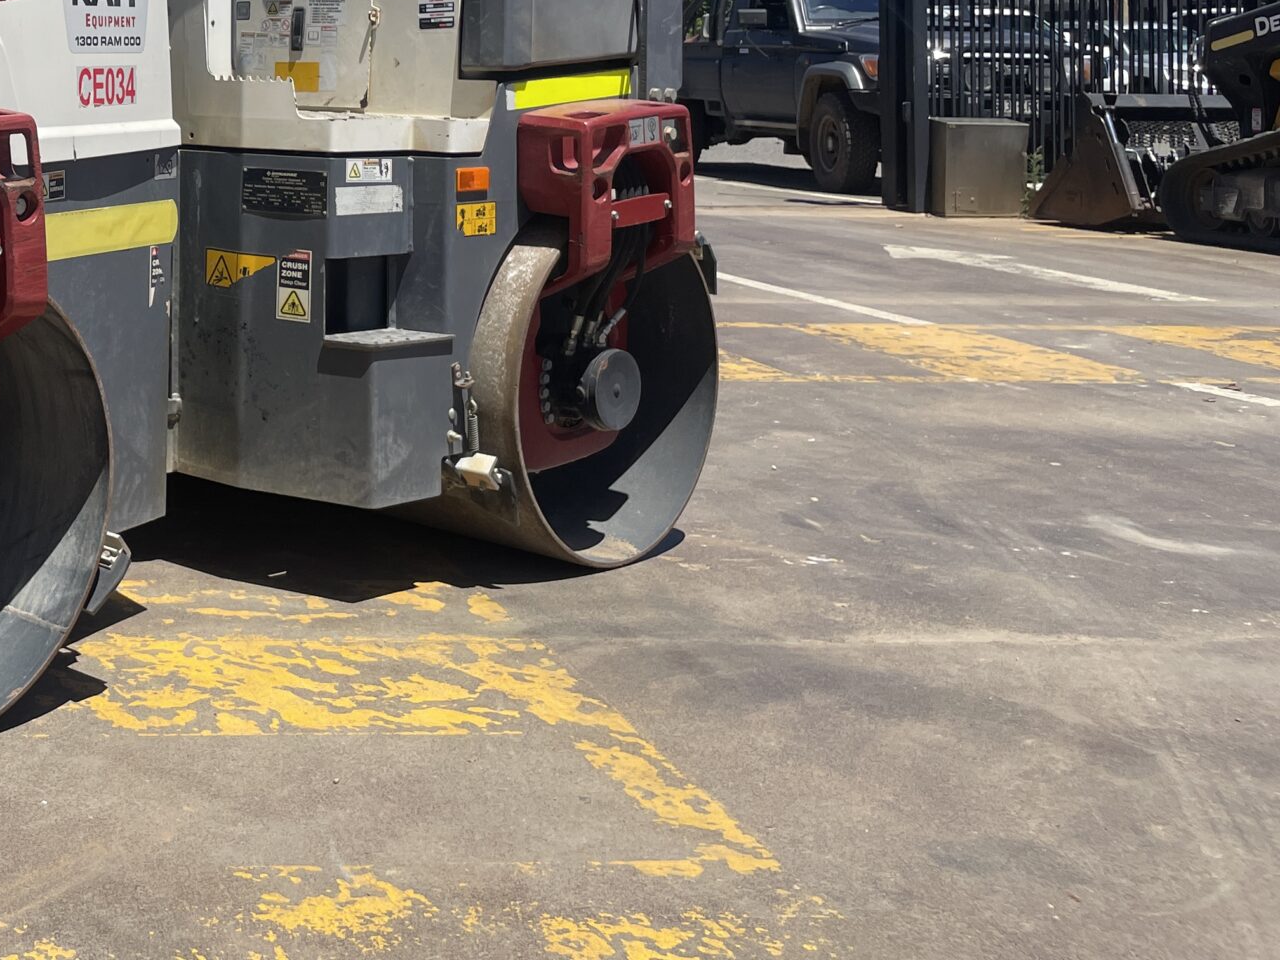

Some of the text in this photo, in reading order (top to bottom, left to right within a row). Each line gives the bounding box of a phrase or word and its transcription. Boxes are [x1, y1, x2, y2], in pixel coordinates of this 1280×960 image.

[85, 13, 136, 29] EQUIPMENT
[74, 36, 141, 47] 1300 RAM 000
[78, 67, 136, 107] CE034
[281, 261, 308, 270] CRUSH
[281, 270, 303, 278] ZONE
